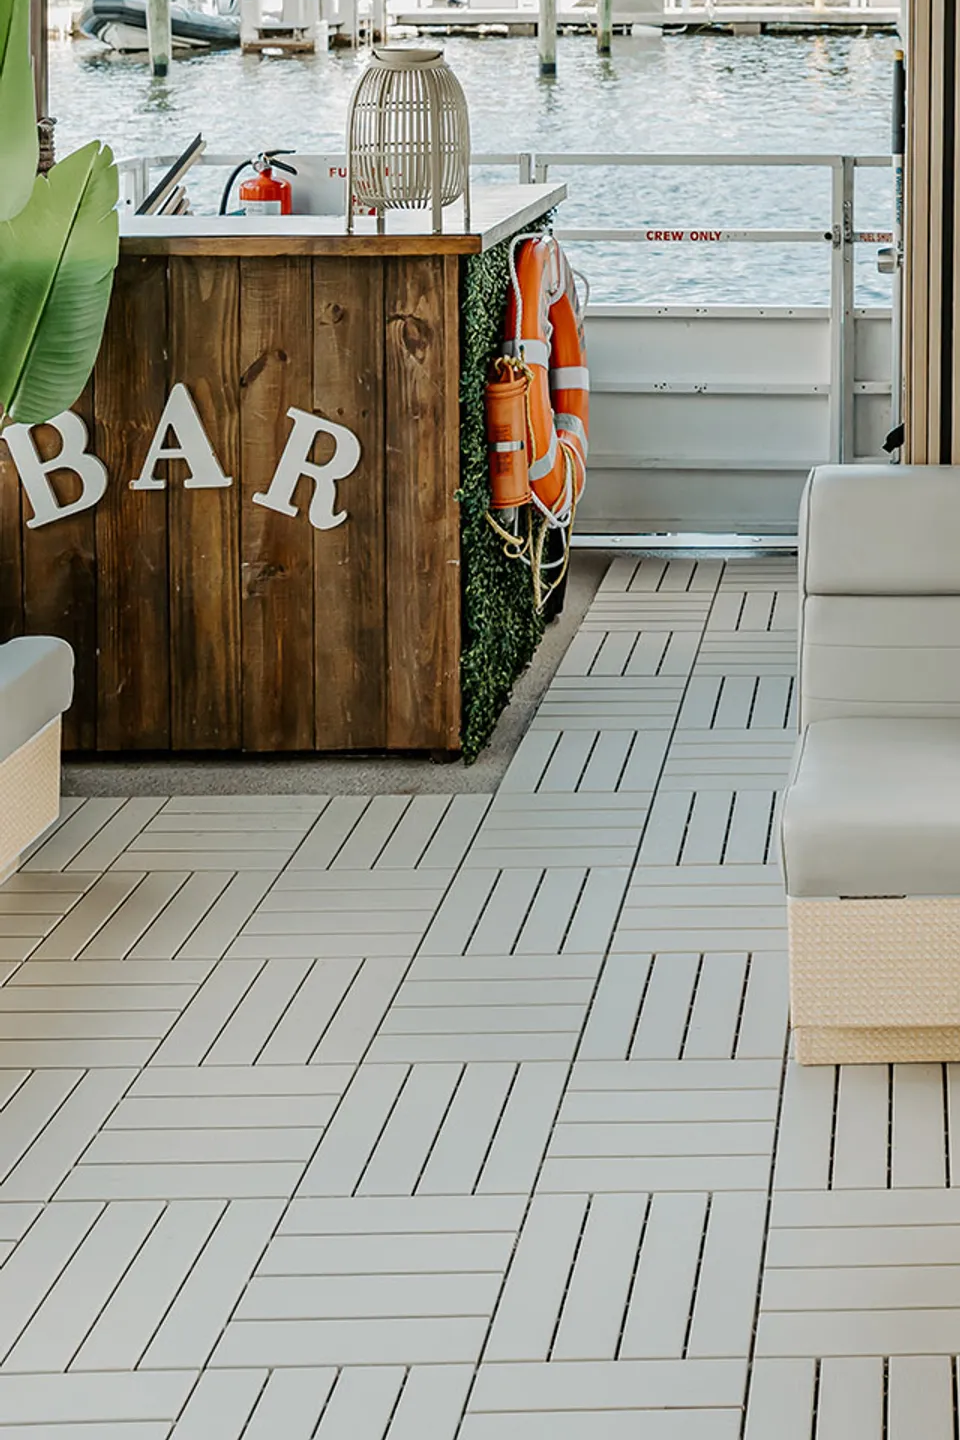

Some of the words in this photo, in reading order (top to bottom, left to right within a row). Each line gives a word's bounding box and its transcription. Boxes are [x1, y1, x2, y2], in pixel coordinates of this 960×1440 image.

[646, 230, 684, 241] CREW
[690, 230, 722, 241] ONLY
[1, 382, 361, 530] BAR
